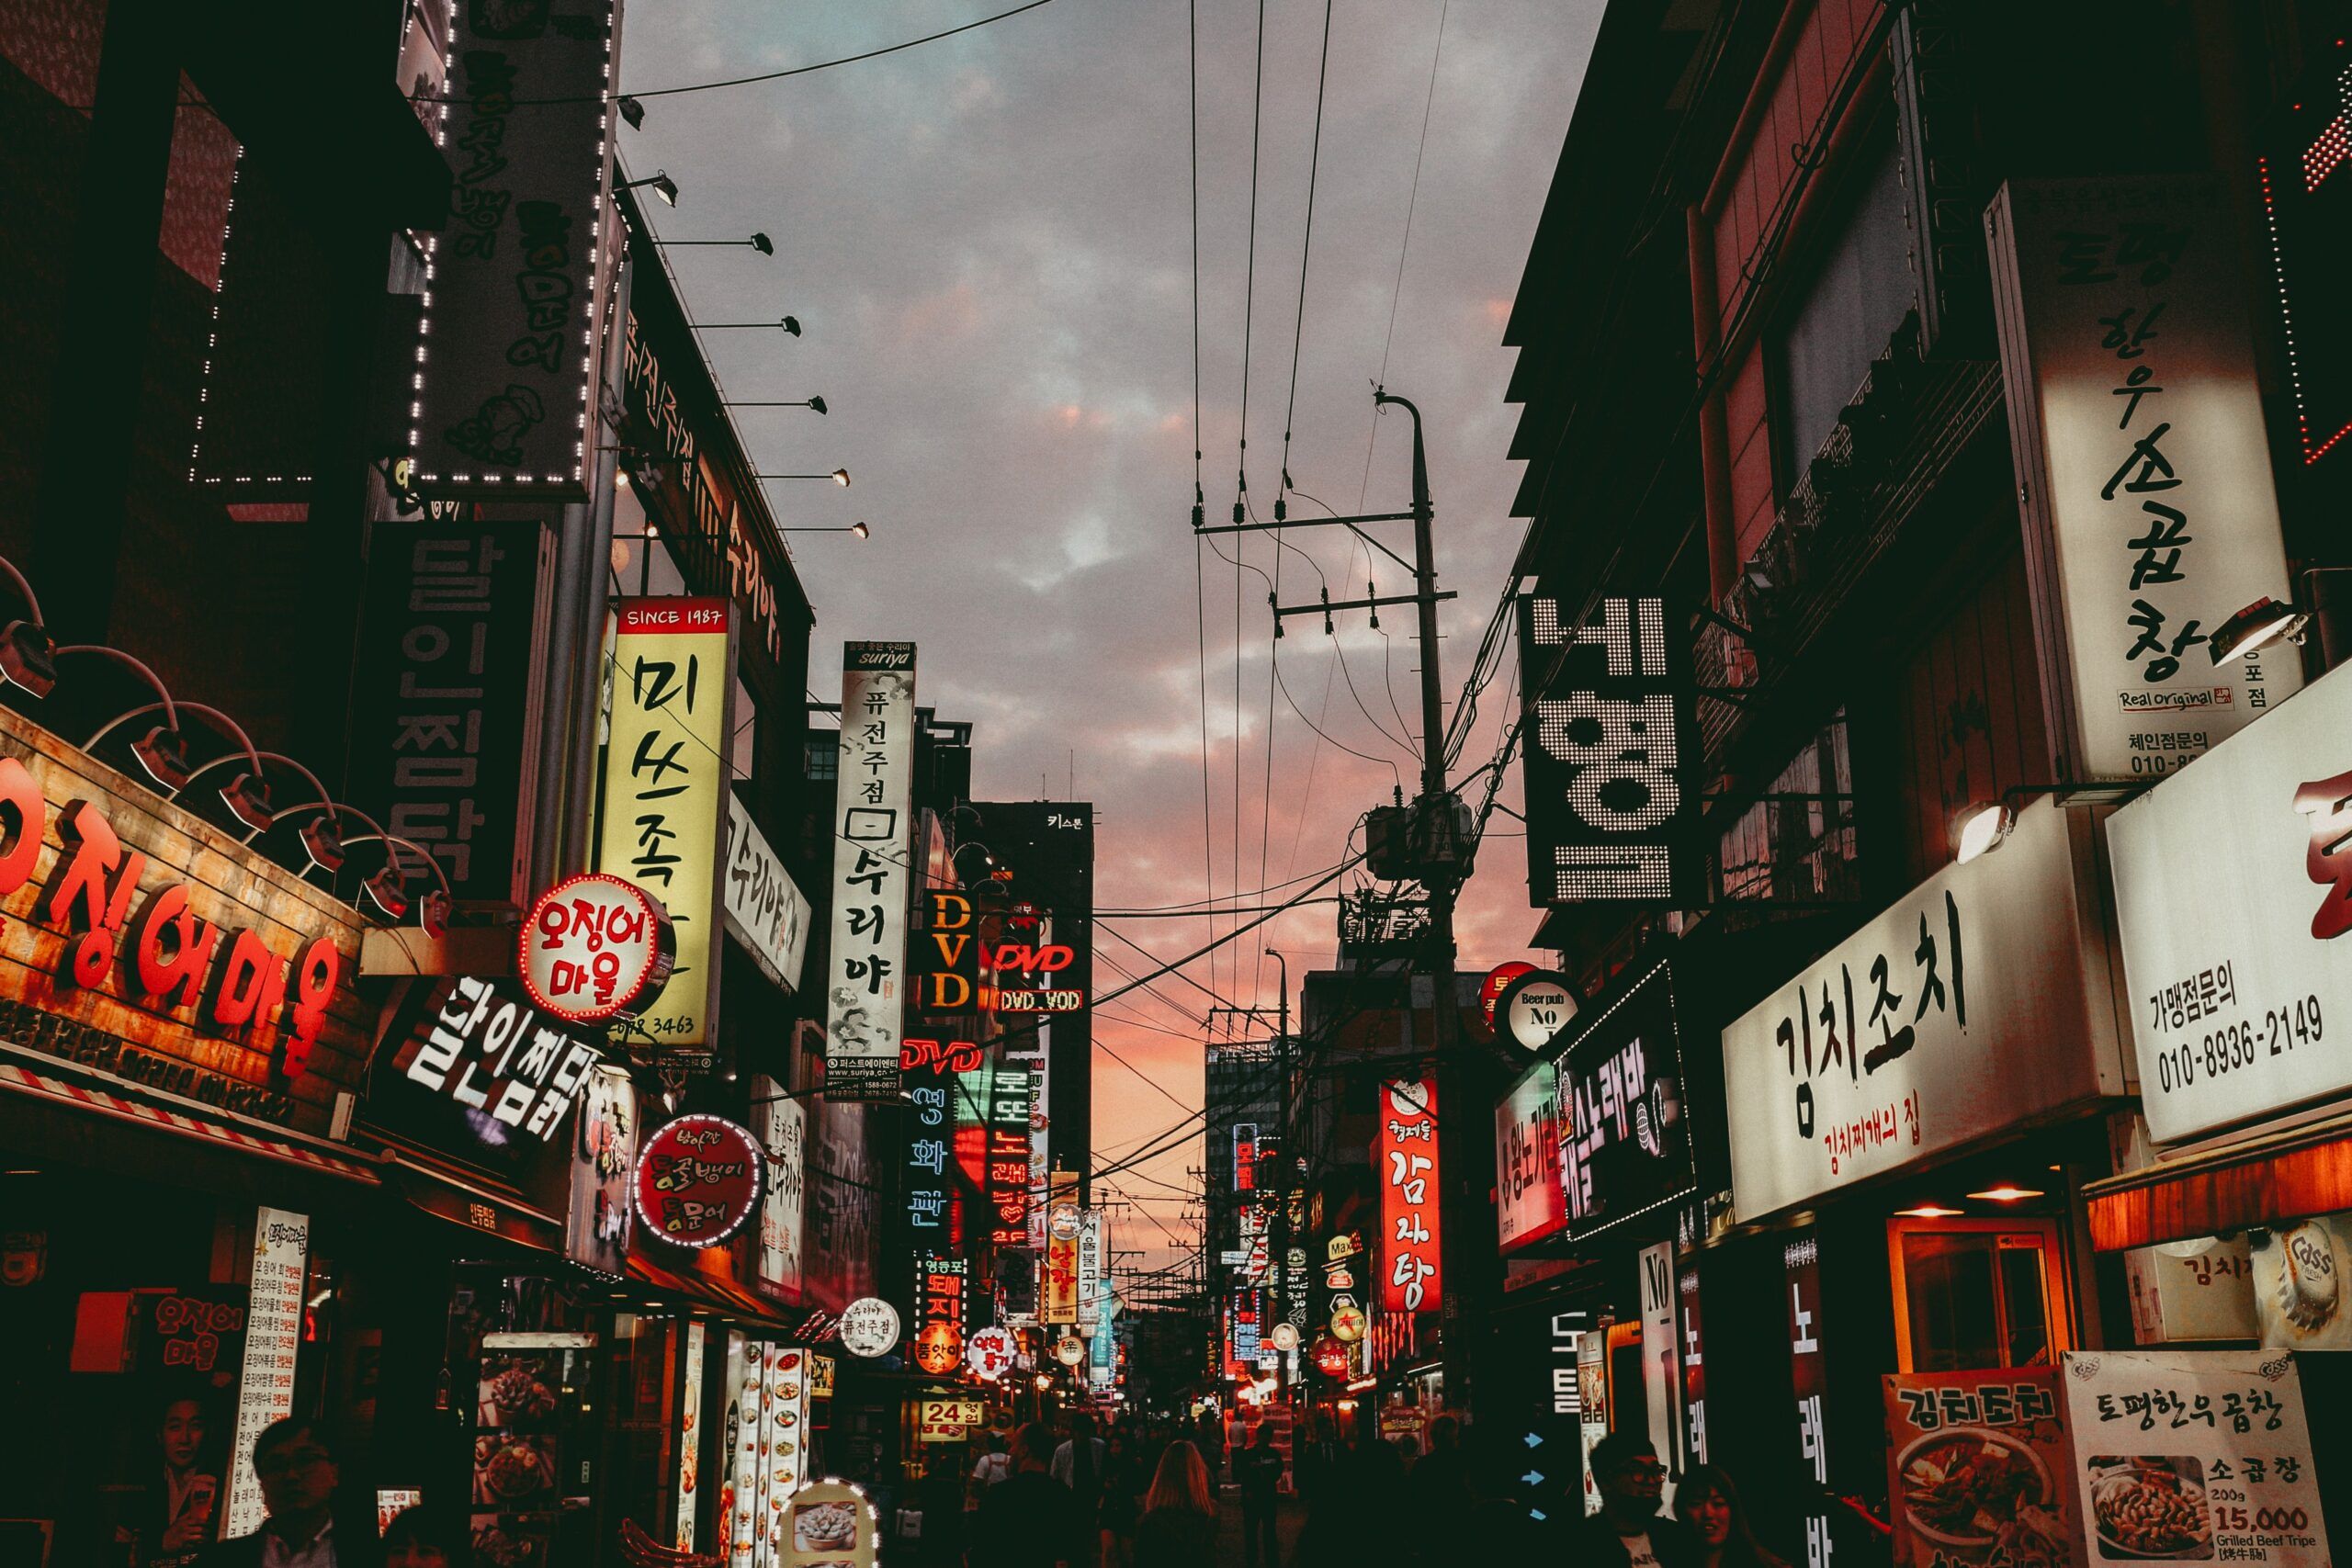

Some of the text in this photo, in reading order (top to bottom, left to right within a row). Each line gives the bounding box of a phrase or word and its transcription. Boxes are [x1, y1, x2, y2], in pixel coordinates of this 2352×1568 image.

[627, 608, 723, 626] SINCE 1987
[858, 650, 910, 669] suriya
[2120, 691, 2152, 706] Real
[860, 692, 889, 805] 퓨전주점
[2129, 731, 2208, 751] 체인점문의
[732, 822, 784, 947] 수리야
[538, 898, 646, 952] 오징어
[845, 849, 892, 995] 수리야
[930, 894, 972, 1009] DVD
[993, 944, 1075, 972] DVD
[550, 952, 619, 1006] 마을
[2150, 960, 2237, 1033] 가맹점문의
[1001, 991, 1035, 1010] DVD
[1521, 993, 1565, 1006] Beer pub
[1777, 889, 1967, 1140] 김치조치
[654, 1015, 694, 1035] 3463
[2158, 993, 2324, 1094] 010-8936-2149
[900, 1039, 983, 1076] DVD
[1825, 1089, 1920, 1176] 김치찌개의 집
[1389, 1150, 1436, 1312] 감자탕
[925, 1260, 963, 1274] 영등포
[2291, 1236, 2333, 1275] Cass
[155, 1296, 243, 1336] 오징어
[844, 1320, 890, 1336] 퓨전주점
[164, 1332, 219, 1371] 마을
[927, 1403, 960, 1422] 24
[1898, 1383, 2055, 1431] 김치조치
[2211, 1488, 2245, 1503] 200g
[2215, 1506, 2309, 1533] 15,000
[2216, 1535, 2317, 1549] Grilled Beef Tripe
